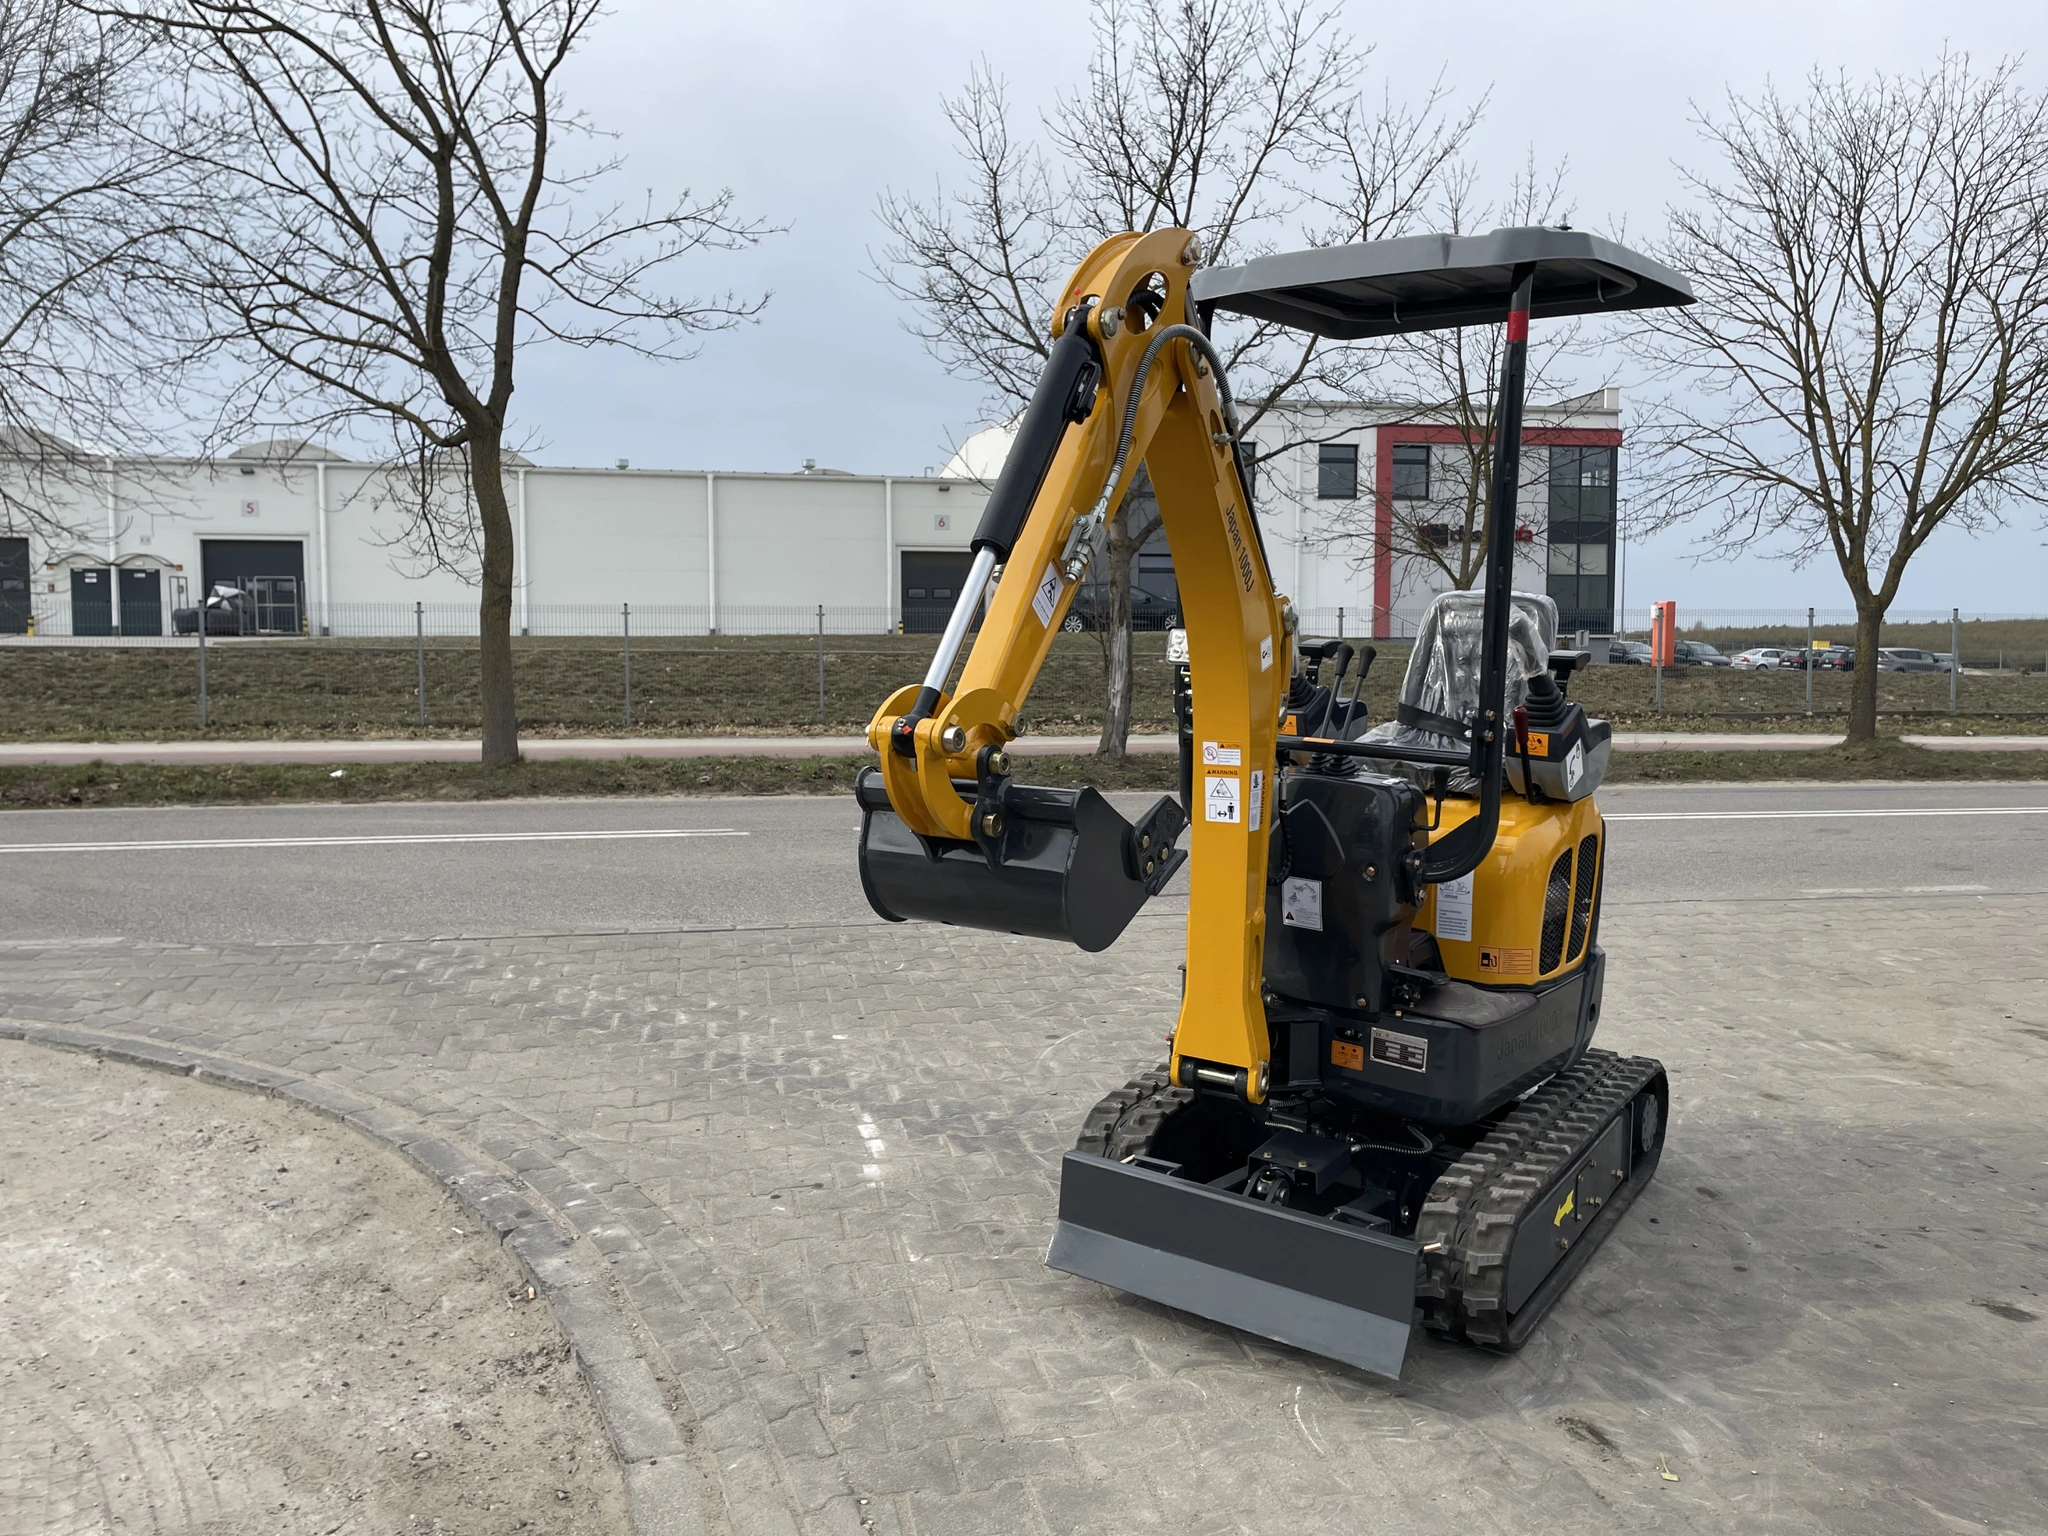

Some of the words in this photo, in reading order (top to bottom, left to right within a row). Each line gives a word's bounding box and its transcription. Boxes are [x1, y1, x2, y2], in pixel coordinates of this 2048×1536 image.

[246, 502, 254, 514] 5
[938, 516, 946, 528] 6
[1226, 503, 1242, 552] Japan
[1238, 547, 1255, 593] 1000J
[1498, 1029, 1532, 1061] Japan
[1536, 1006, 1563, 1041] 1000J
